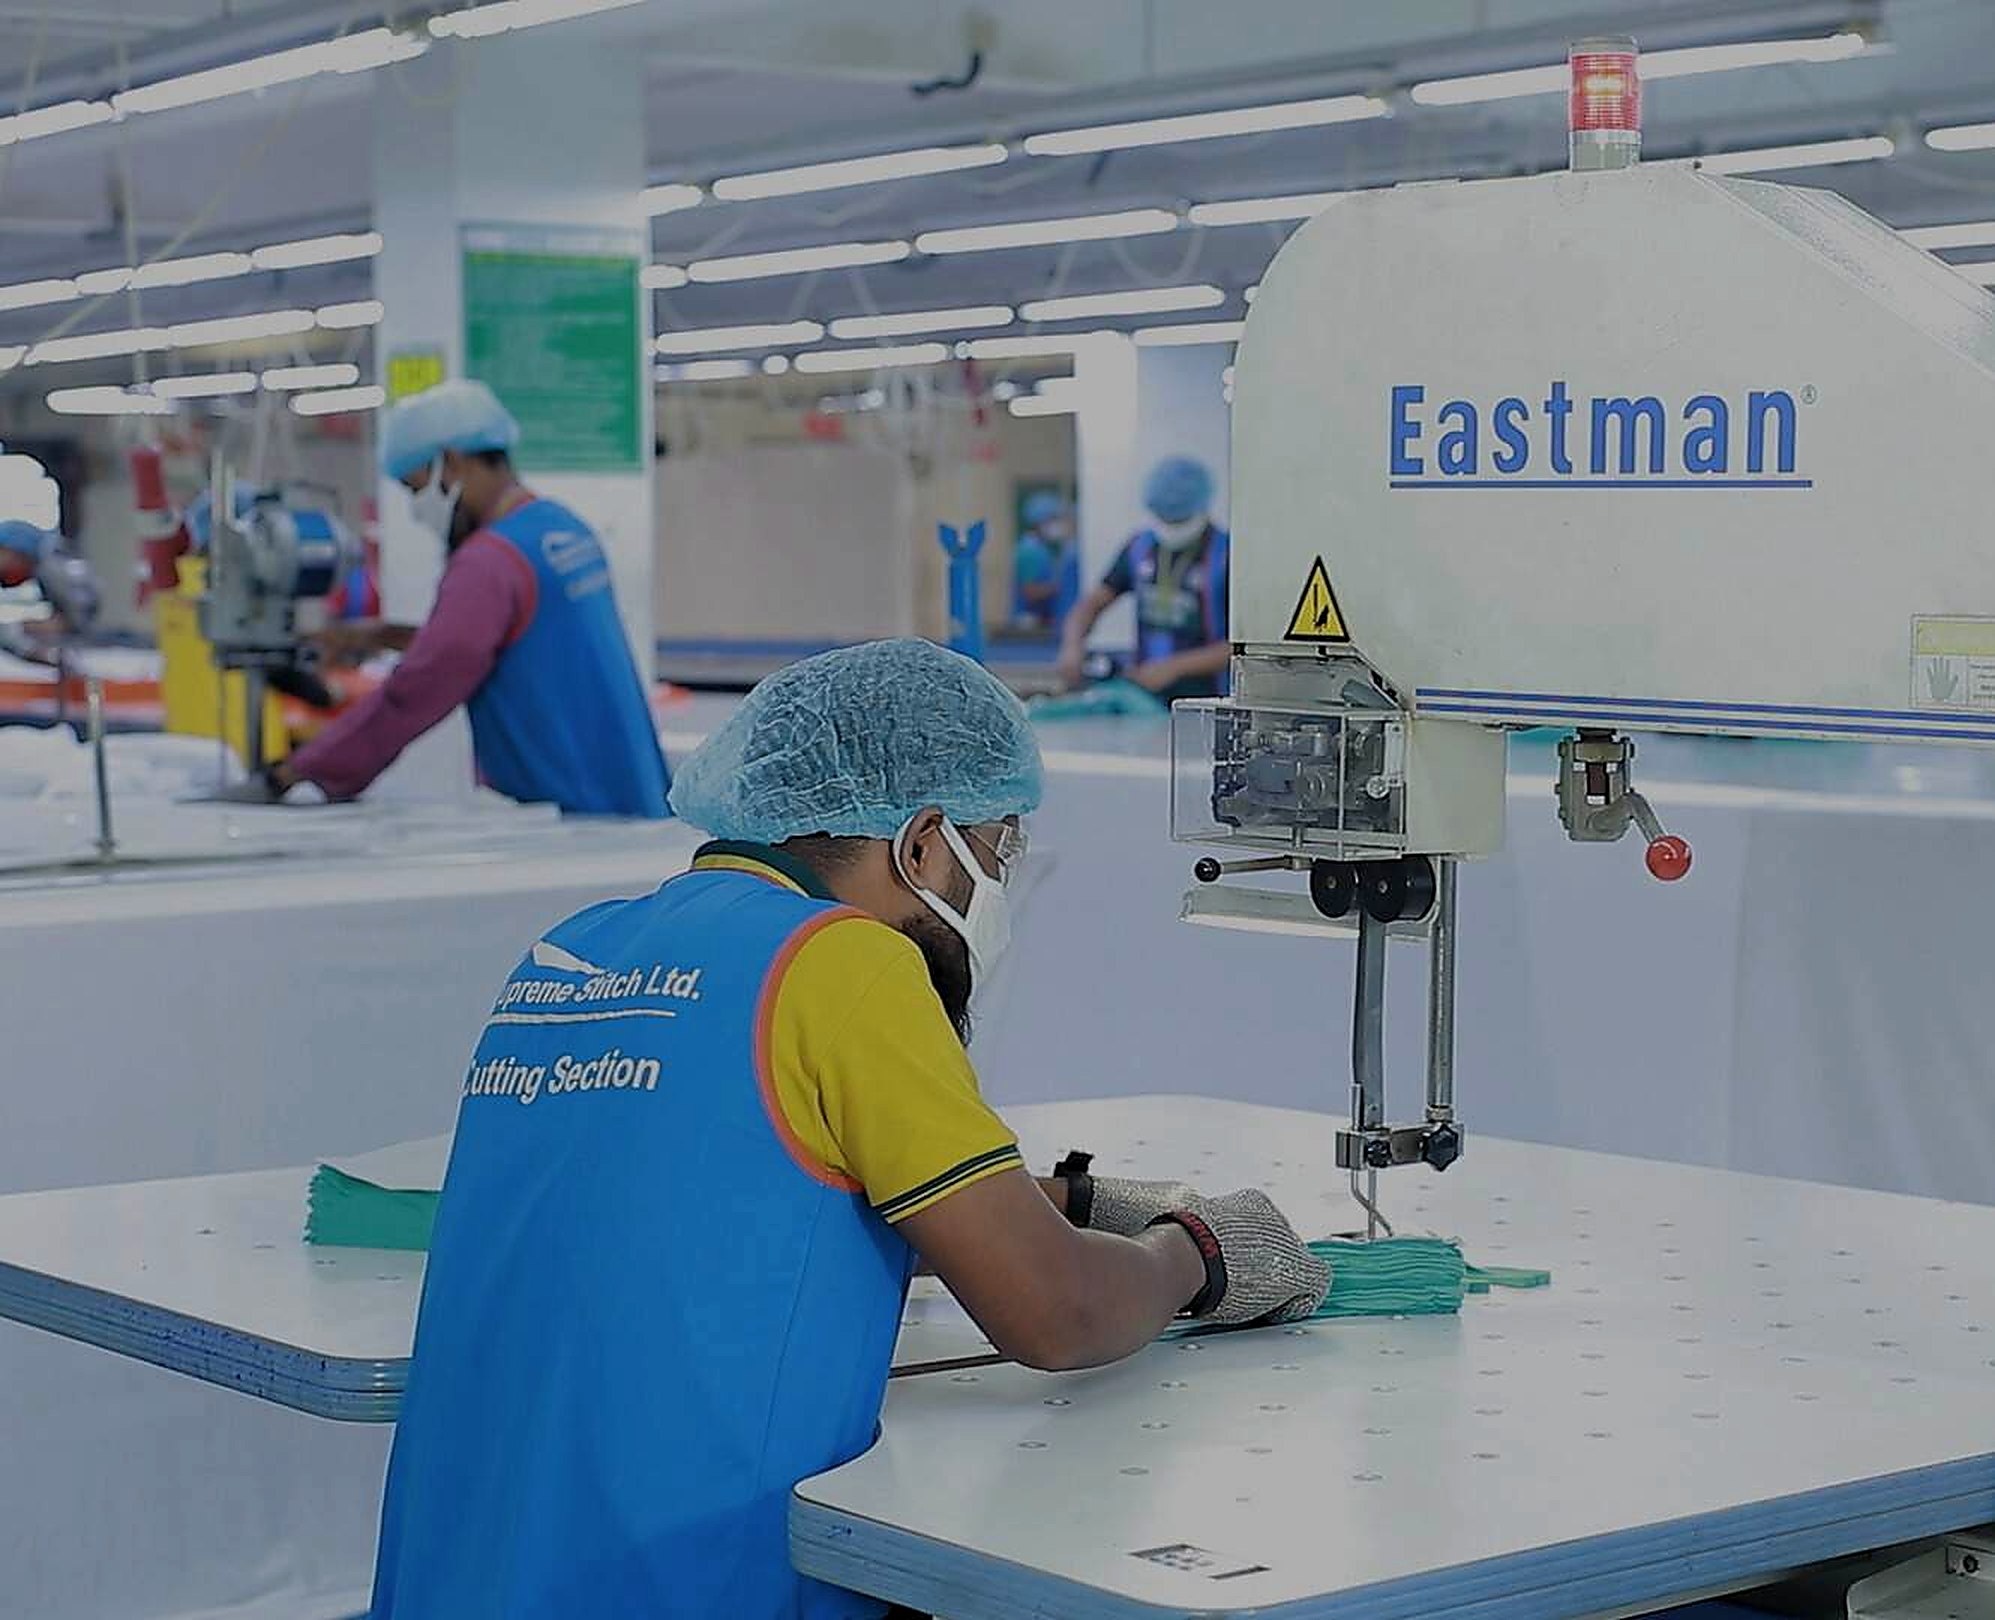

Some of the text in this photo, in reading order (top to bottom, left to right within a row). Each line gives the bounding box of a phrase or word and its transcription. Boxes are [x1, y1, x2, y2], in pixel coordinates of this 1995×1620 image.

[1390, 382, 1797, 475] Eastman
[499, 965, 700, 1010] preme Stitch Ltd.
[549, 1050, 661, 1093] Section
